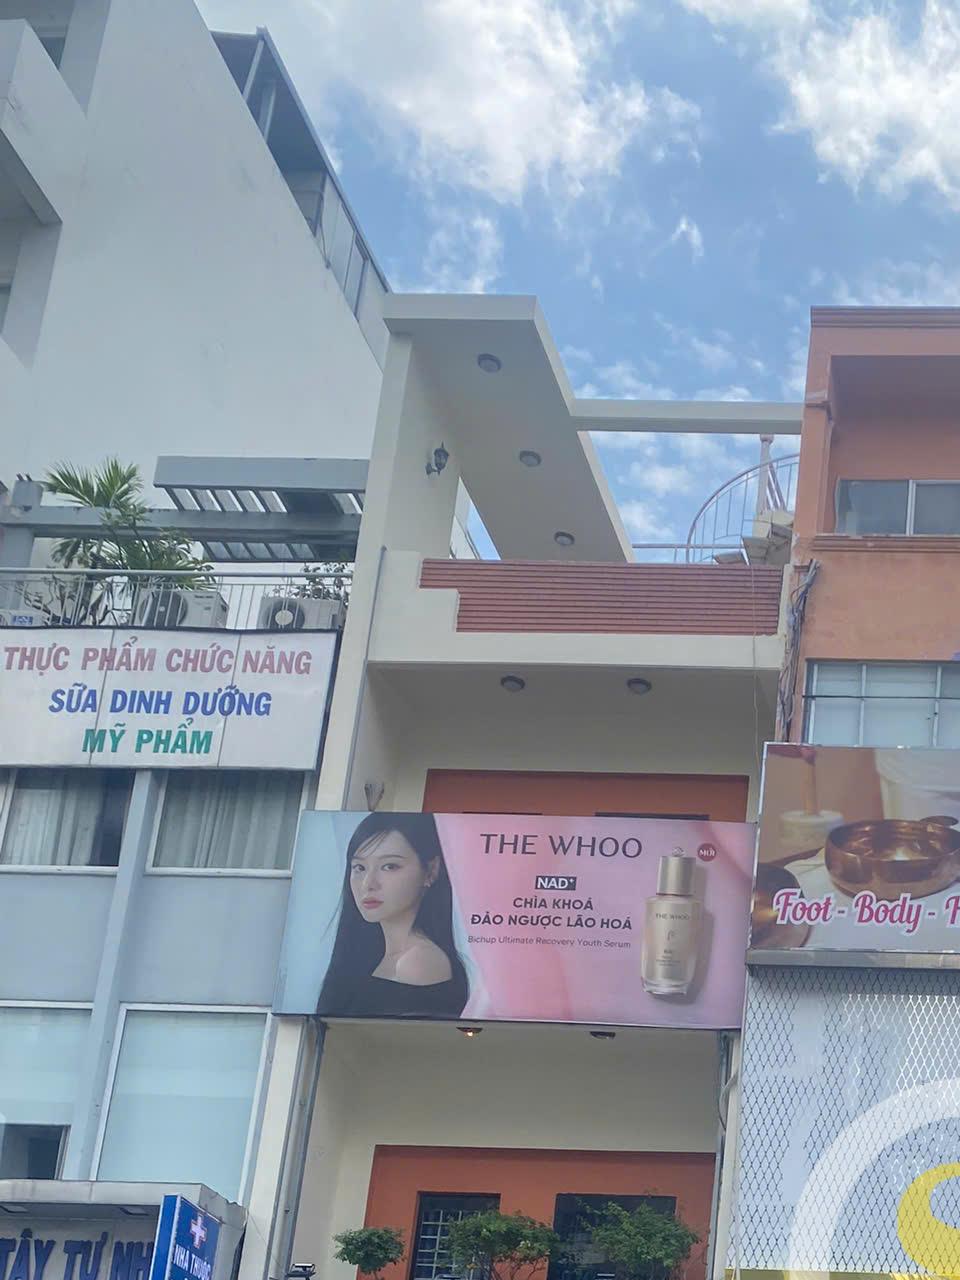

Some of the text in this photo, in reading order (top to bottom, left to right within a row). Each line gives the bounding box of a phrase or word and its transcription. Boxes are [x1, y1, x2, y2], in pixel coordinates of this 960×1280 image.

[4, 636, 313, 677] THỰC PHẨM CHỨC NĂNG
[49, 682, 272, 717] SỮA DINH DƯỠNG
[82, 718, 213, 754] MỸ PHẨM
[480, 833, 643, 858] THE WHOO
[513, 896, 594, 911] CHÌA KHOÁ
[775, 891, 833, 924] Foot
[855, 894, 923, 934] Body
[471, 913, 633, 931] ĐẢO NGƯỢC LÃO HOÁ
[467, 935, 631, 949] Bichup Ultimate Recovery Youth Serum
[173, 1244, 190, 1271] NHÀ
